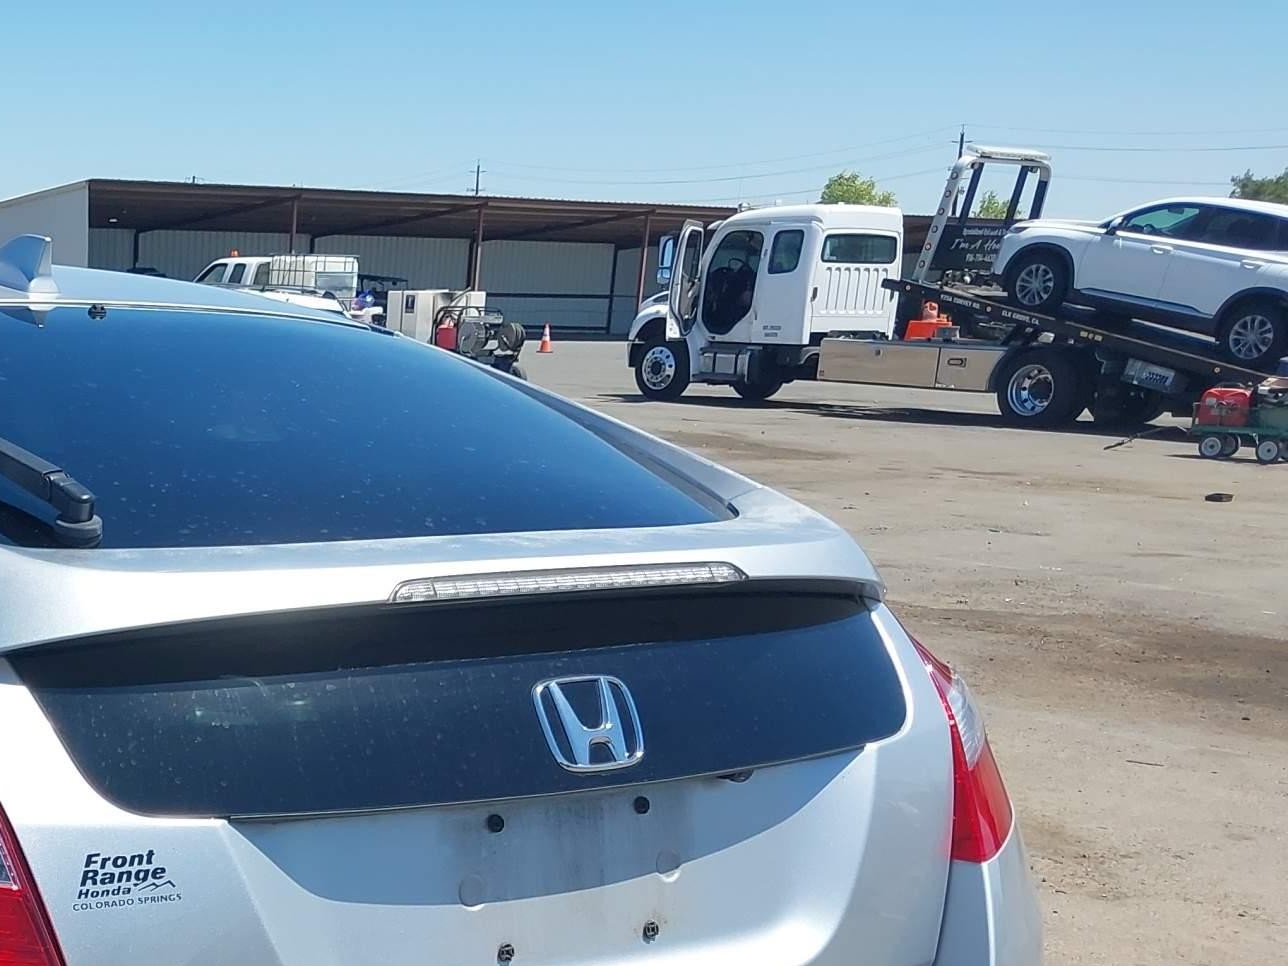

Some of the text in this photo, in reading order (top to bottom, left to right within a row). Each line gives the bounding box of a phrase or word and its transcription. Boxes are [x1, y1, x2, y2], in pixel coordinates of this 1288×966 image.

[84, 849, 155, 870] Front
[80, 866, 167, 887] Range
[77, 885, 132, 899] Honda
[72, 893, 182, 911] COLORADO SPRINGS
